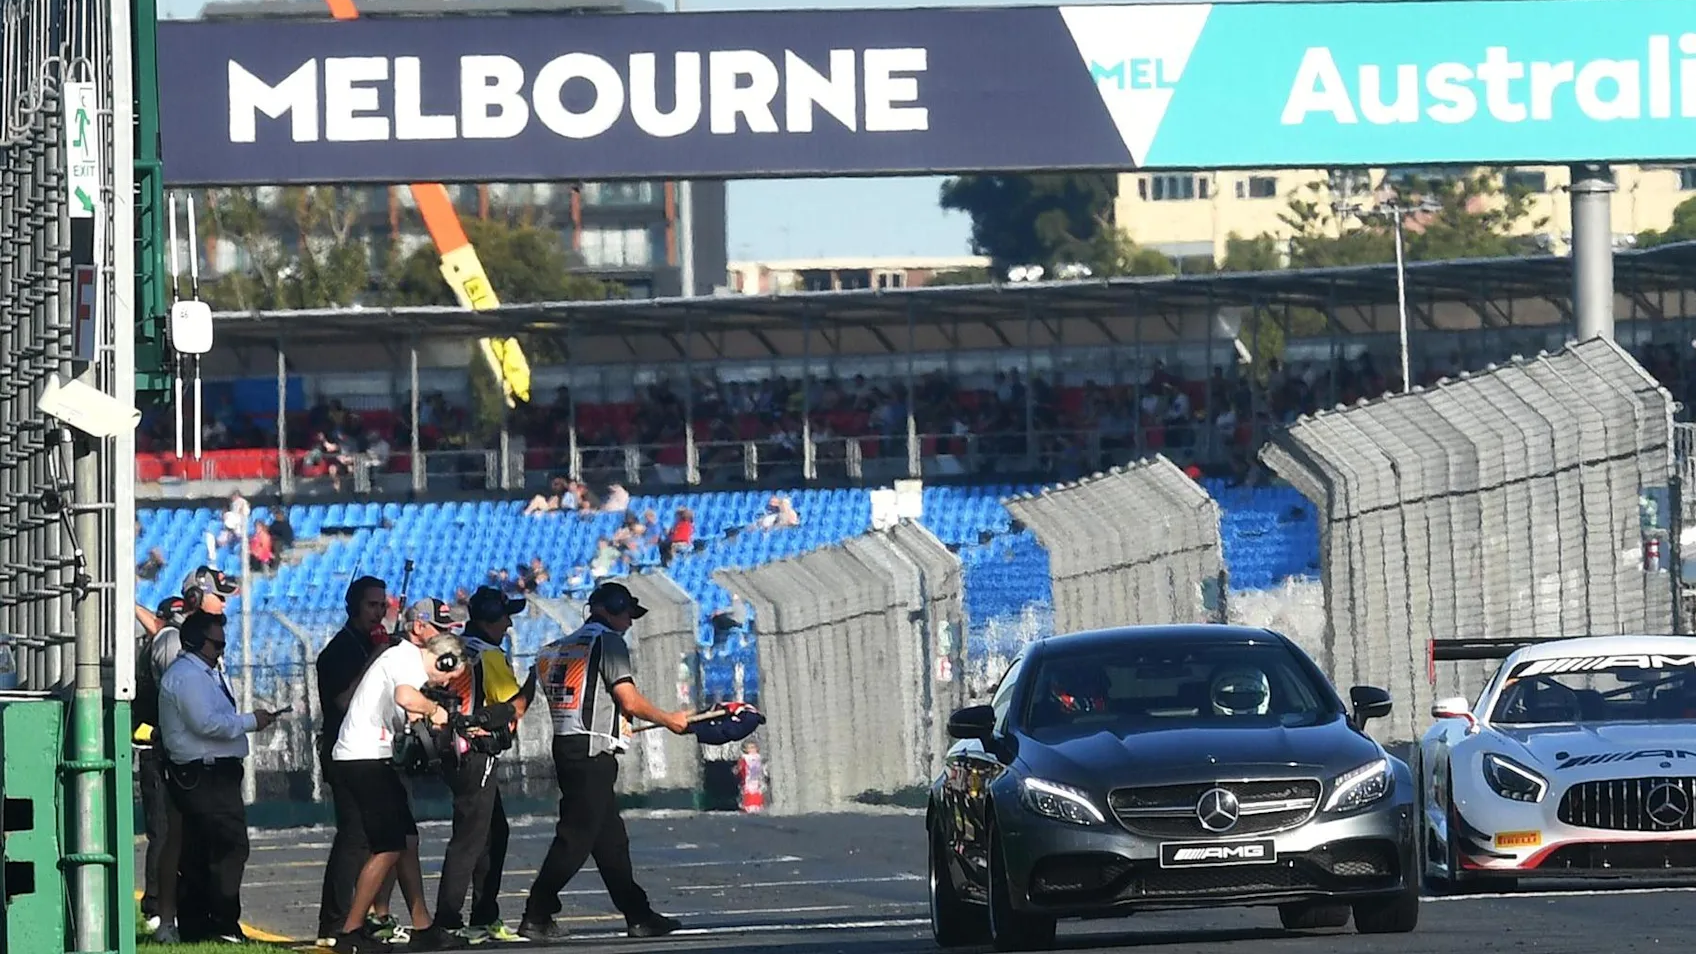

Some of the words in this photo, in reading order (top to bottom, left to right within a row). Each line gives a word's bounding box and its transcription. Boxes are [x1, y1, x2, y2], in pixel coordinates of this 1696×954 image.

[1092, 58, 1178, 90] MEL
[228, 48, 928, 143] MELBOURNE
[73, 165, 96, 178] EXIT
[74, 269, 93, 356] F
[1200, 844, 1265, 860] AMG
